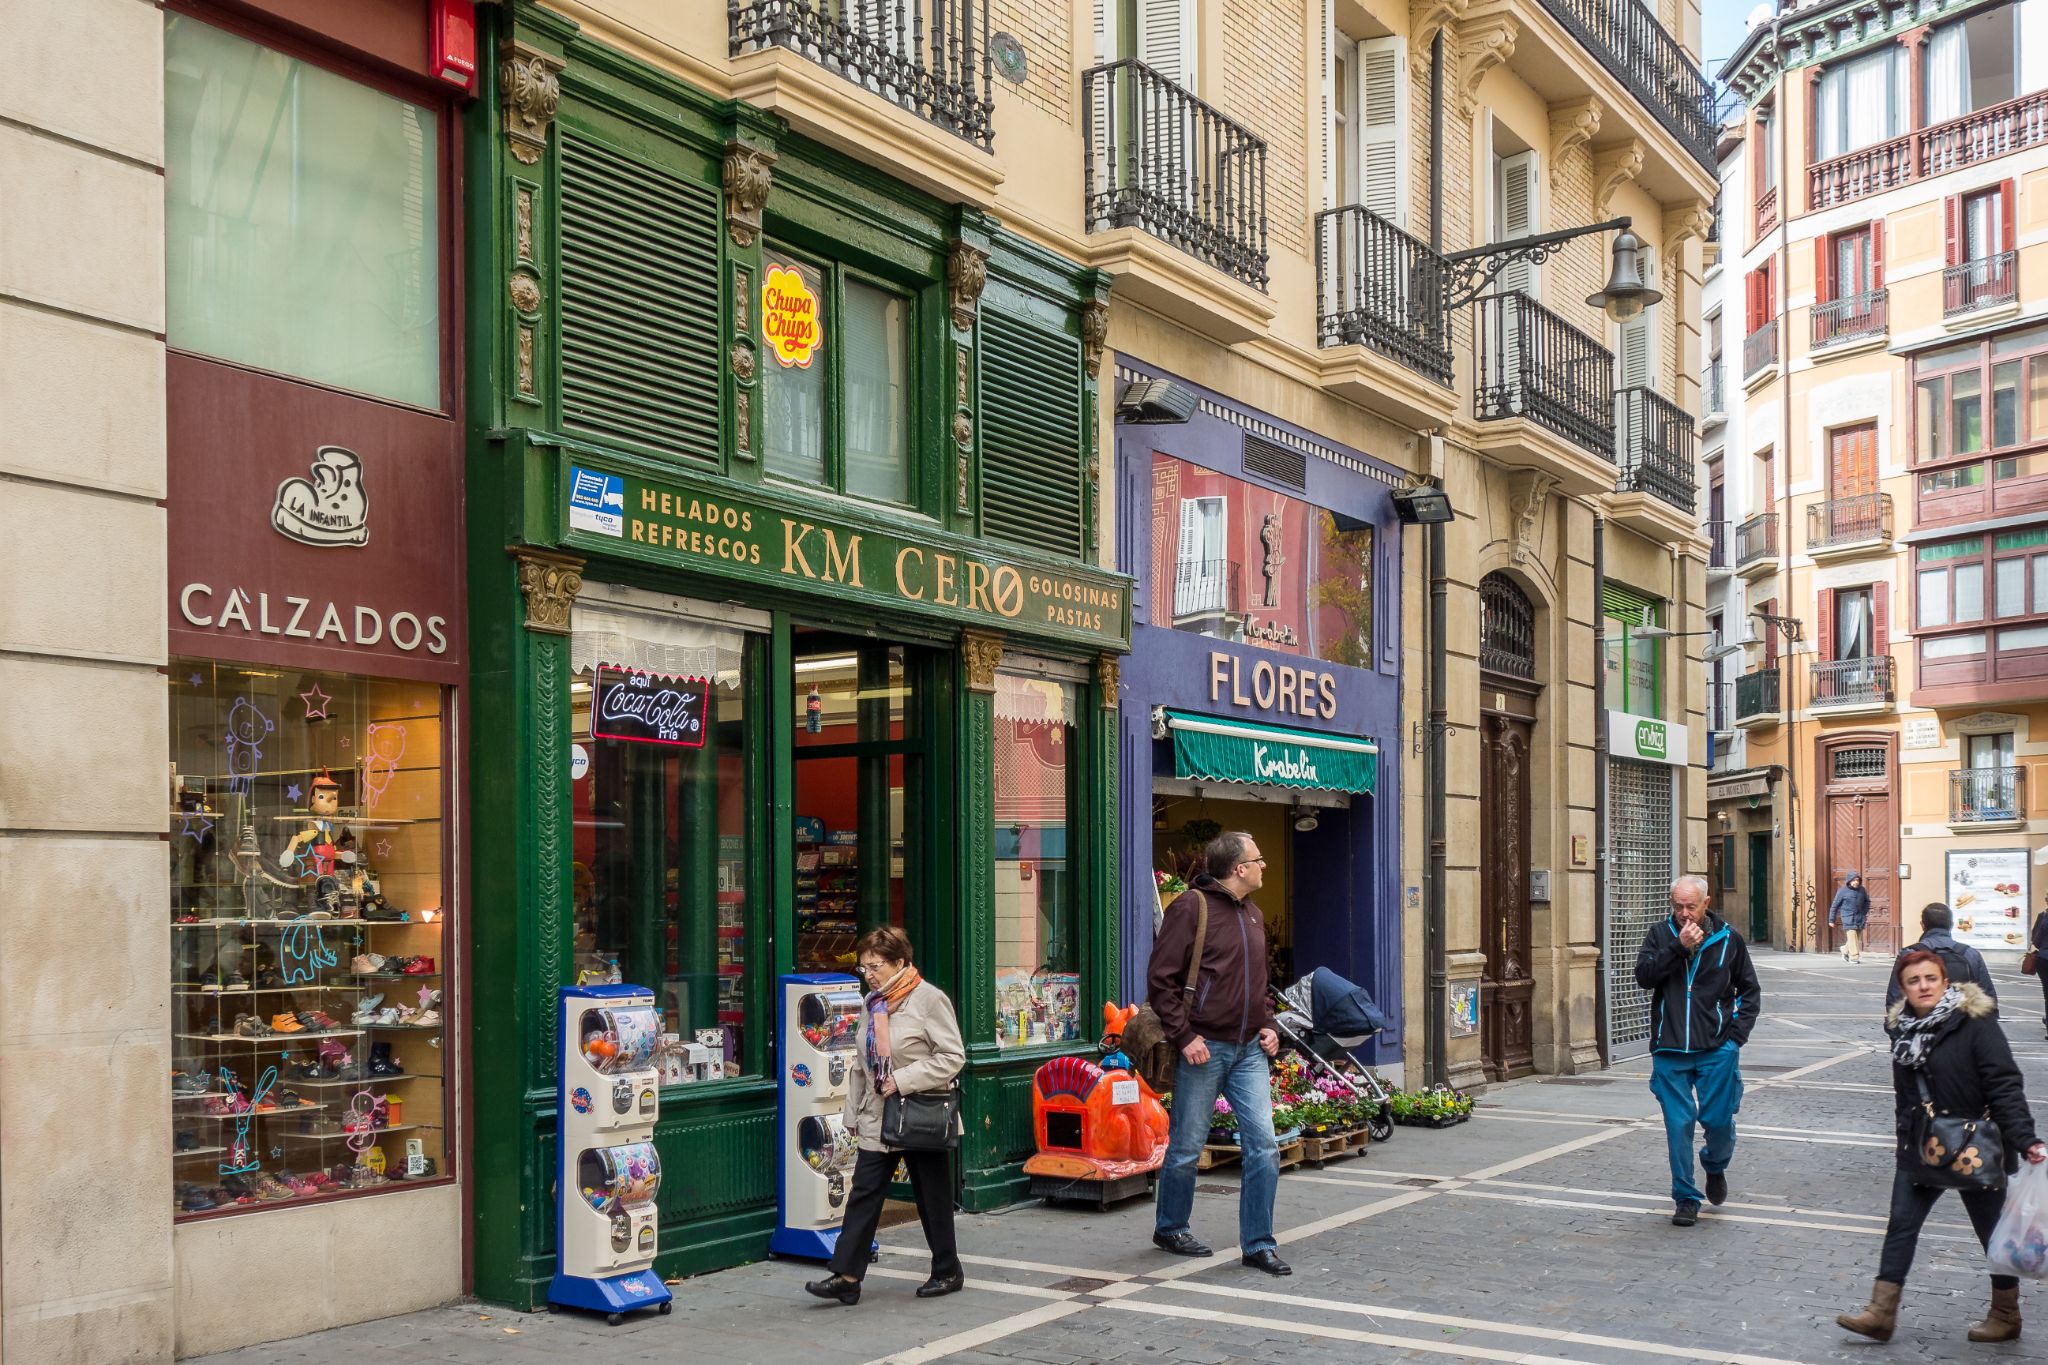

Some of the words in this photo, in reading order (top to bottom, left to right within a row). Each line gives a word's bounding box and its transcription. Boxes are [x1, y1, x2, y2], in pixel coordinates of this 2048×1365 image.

[765, 287, 812, 319] Chupa
[765, 312, 813, 352] Chups
[289, 496, 305, 517] LA
[310, 508, 353, 528] INFANTIL
[595, 513, 614, 523] tyco
[641, 488, 752, 532] HELADOS
[632, 519, 761, 565] REFRESCOS
[780, 518, 864, 588] KM
[1029, 575, 1119, 610] GOLOSINAS
[180, 582, 448, 655] CALZADOS
[1047, 605, 1101, 631] PASTAS
[1211, 651, 1336, 720] FLORES
[602, 683, 696, 730] Coca-Cola
[571, 758, 587, 767] yco
[1254, 742, 1319, 783] Krabelin
